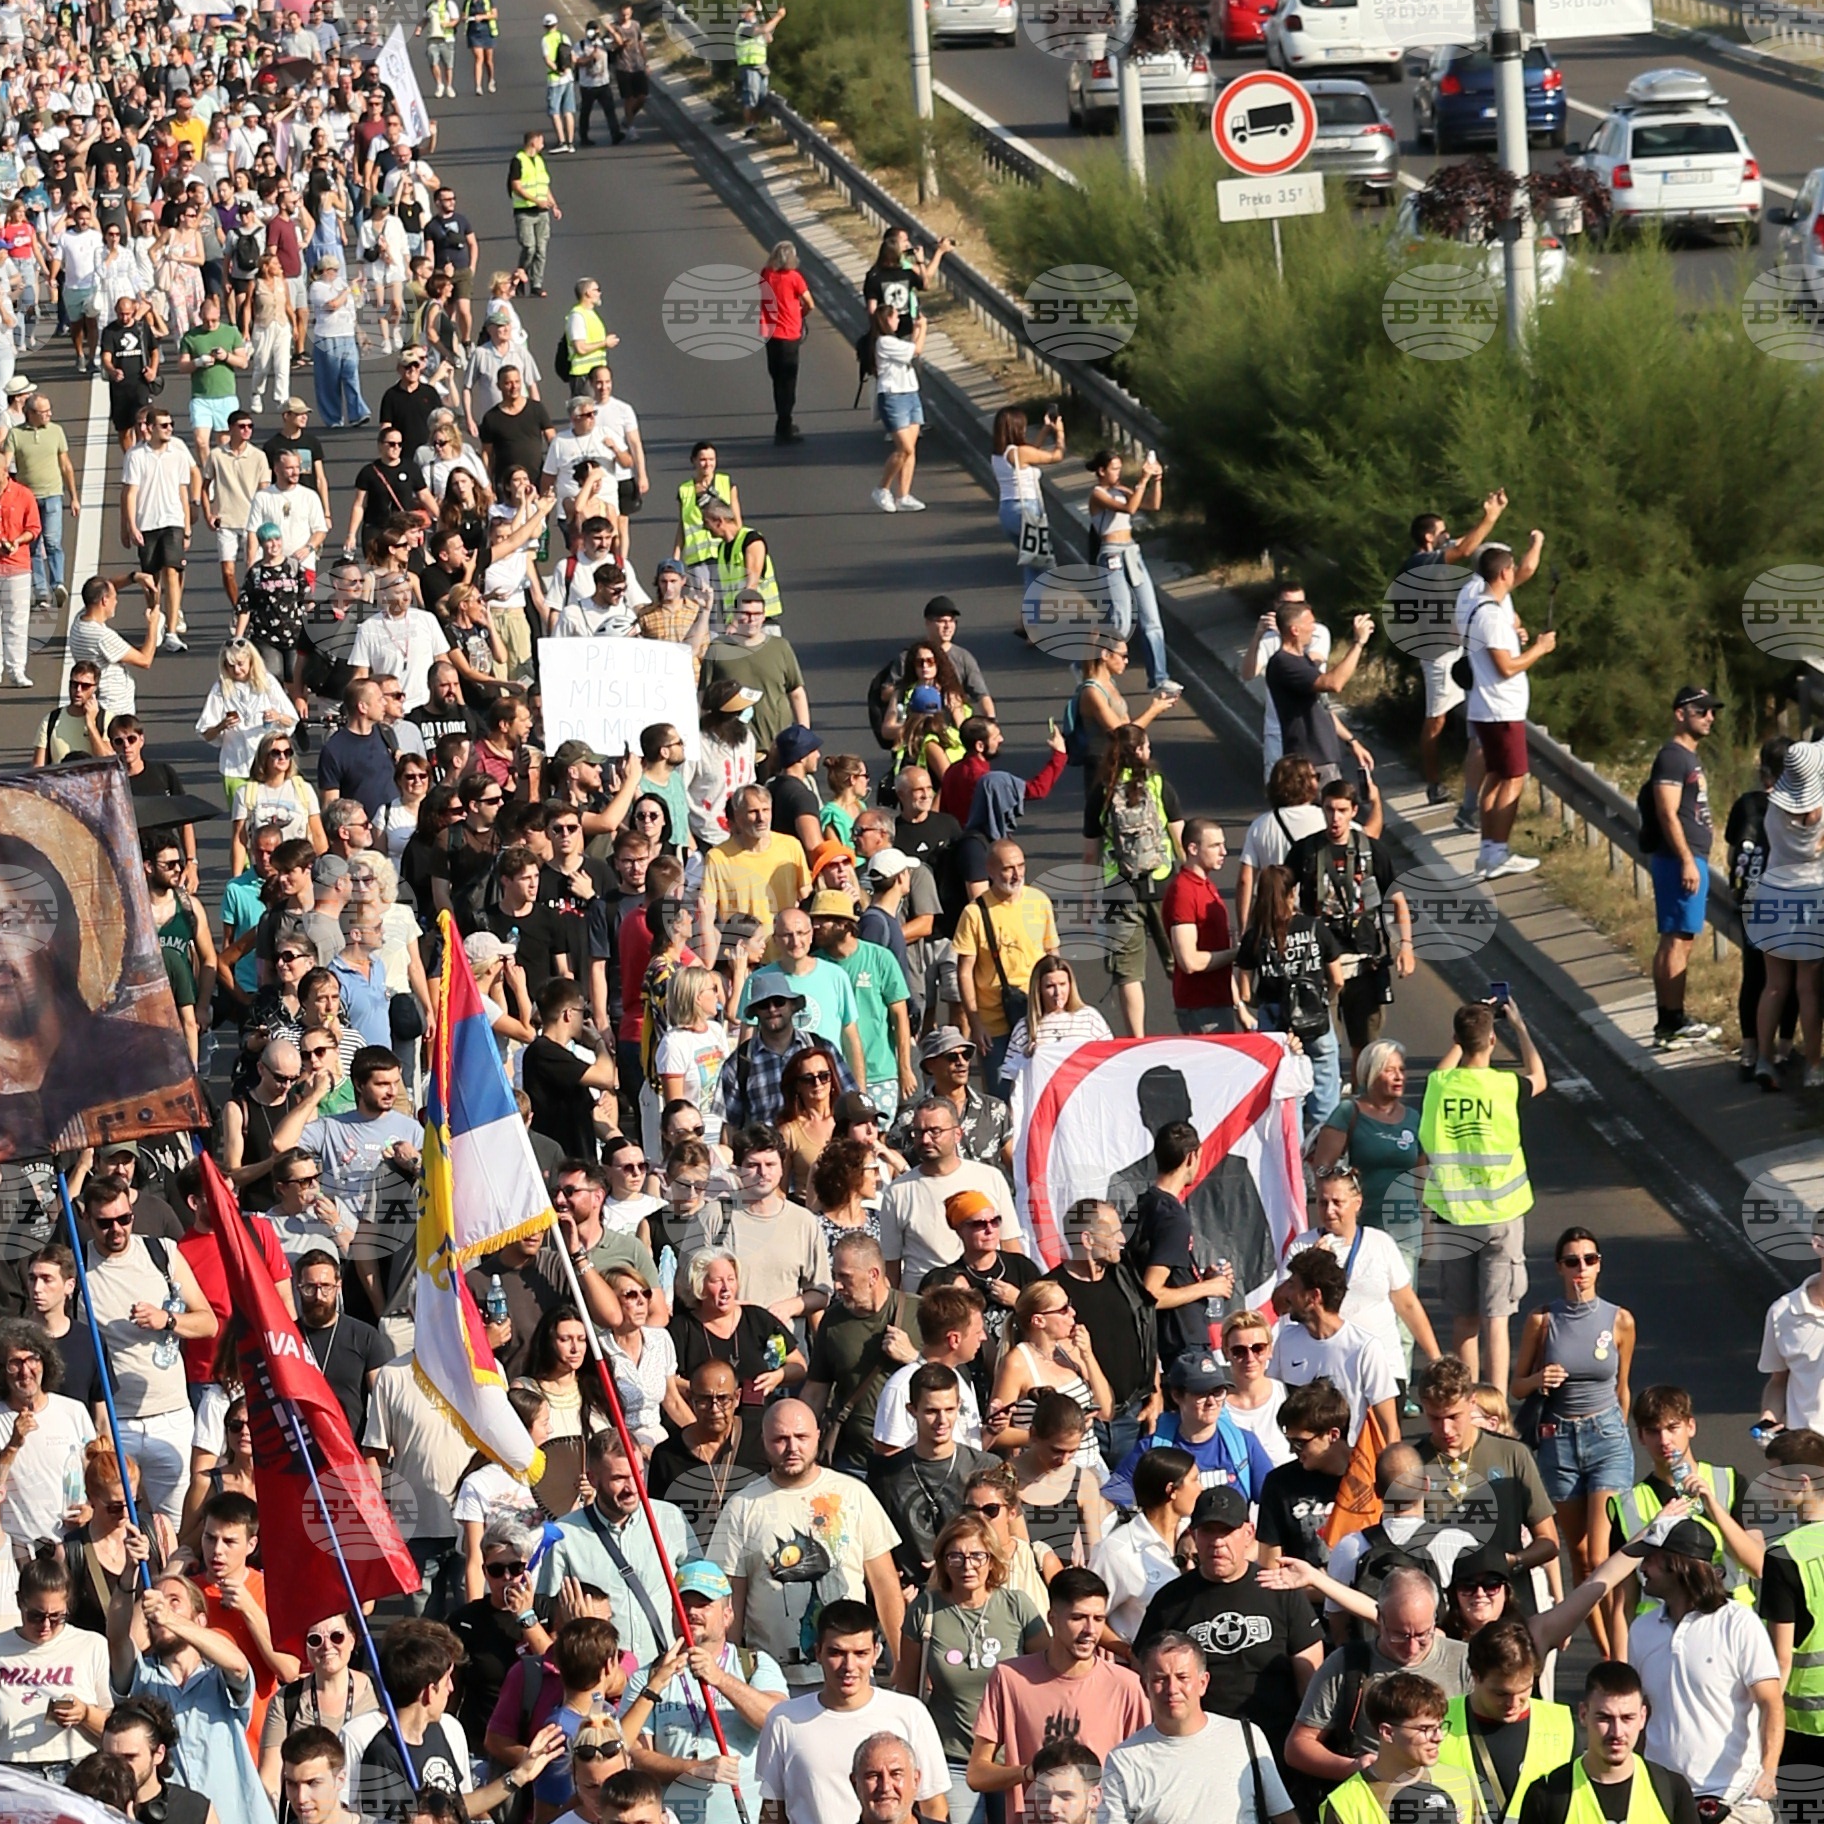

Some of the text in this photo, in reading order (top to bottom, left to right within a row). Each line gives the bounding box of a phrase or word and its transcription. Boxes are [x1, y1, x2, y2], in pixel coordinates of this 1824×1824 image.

[1373, 7, 1439, 23] SRBIJA
[1239, 193, 1273, 207] Preko
[1443, 1097, 1493, 1120] FPN
